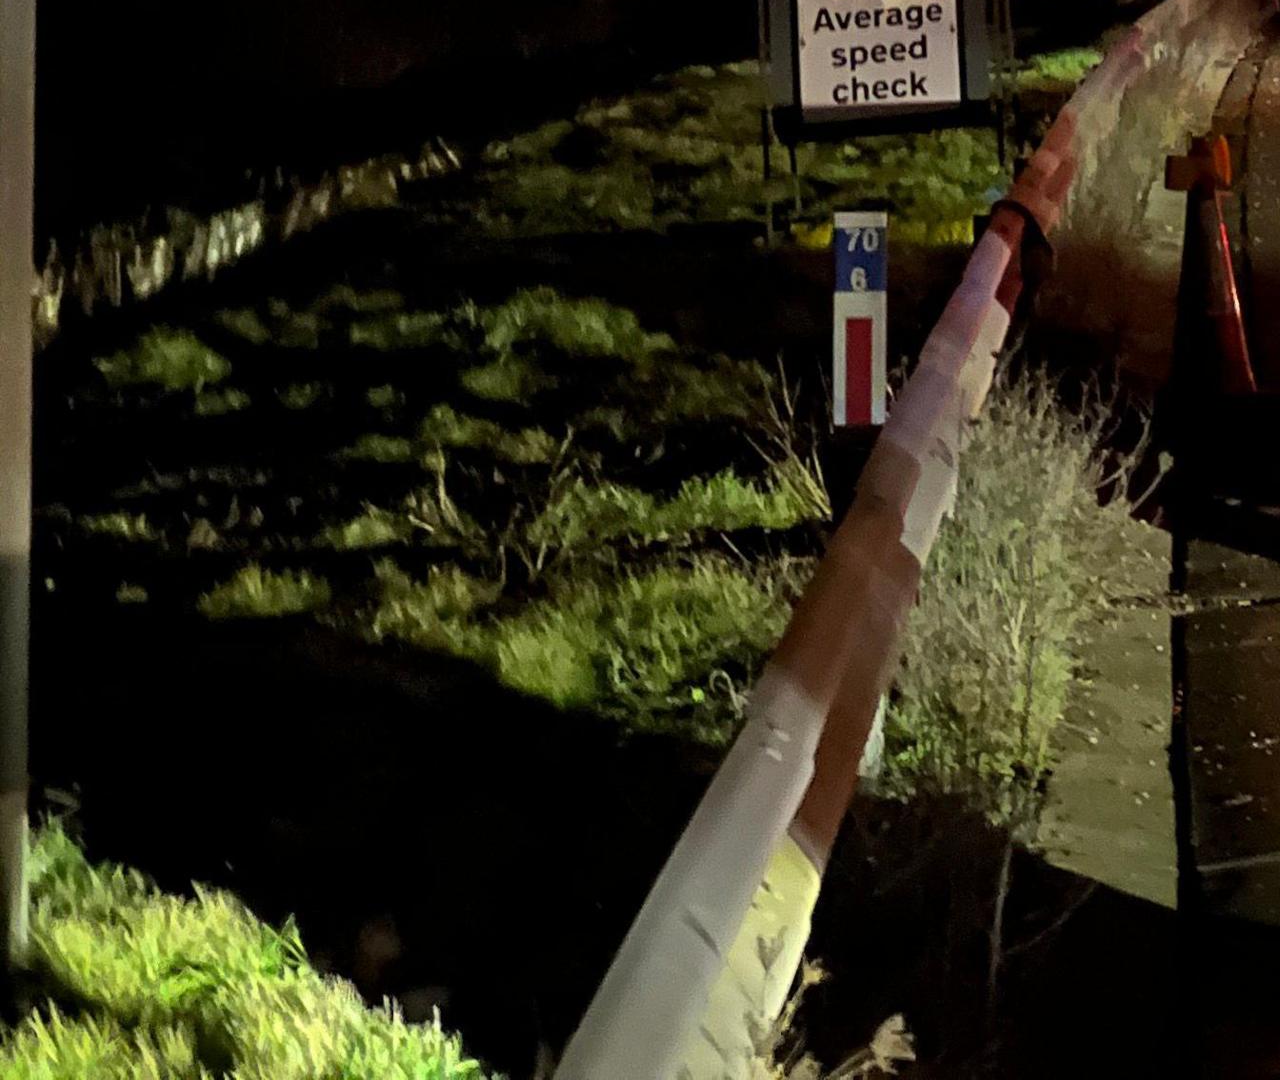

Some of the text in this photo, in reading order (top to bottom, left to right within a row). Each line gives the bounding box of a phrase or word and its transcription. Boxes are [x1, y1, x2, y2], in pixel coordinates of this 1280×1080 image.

[813, 2, 942, 34] Average
[832, 34, 927, 70] speed
[832, 71, 928, 104] check
[845, 227, 879, 252] 70
[850, 267, 867, 292] 6
